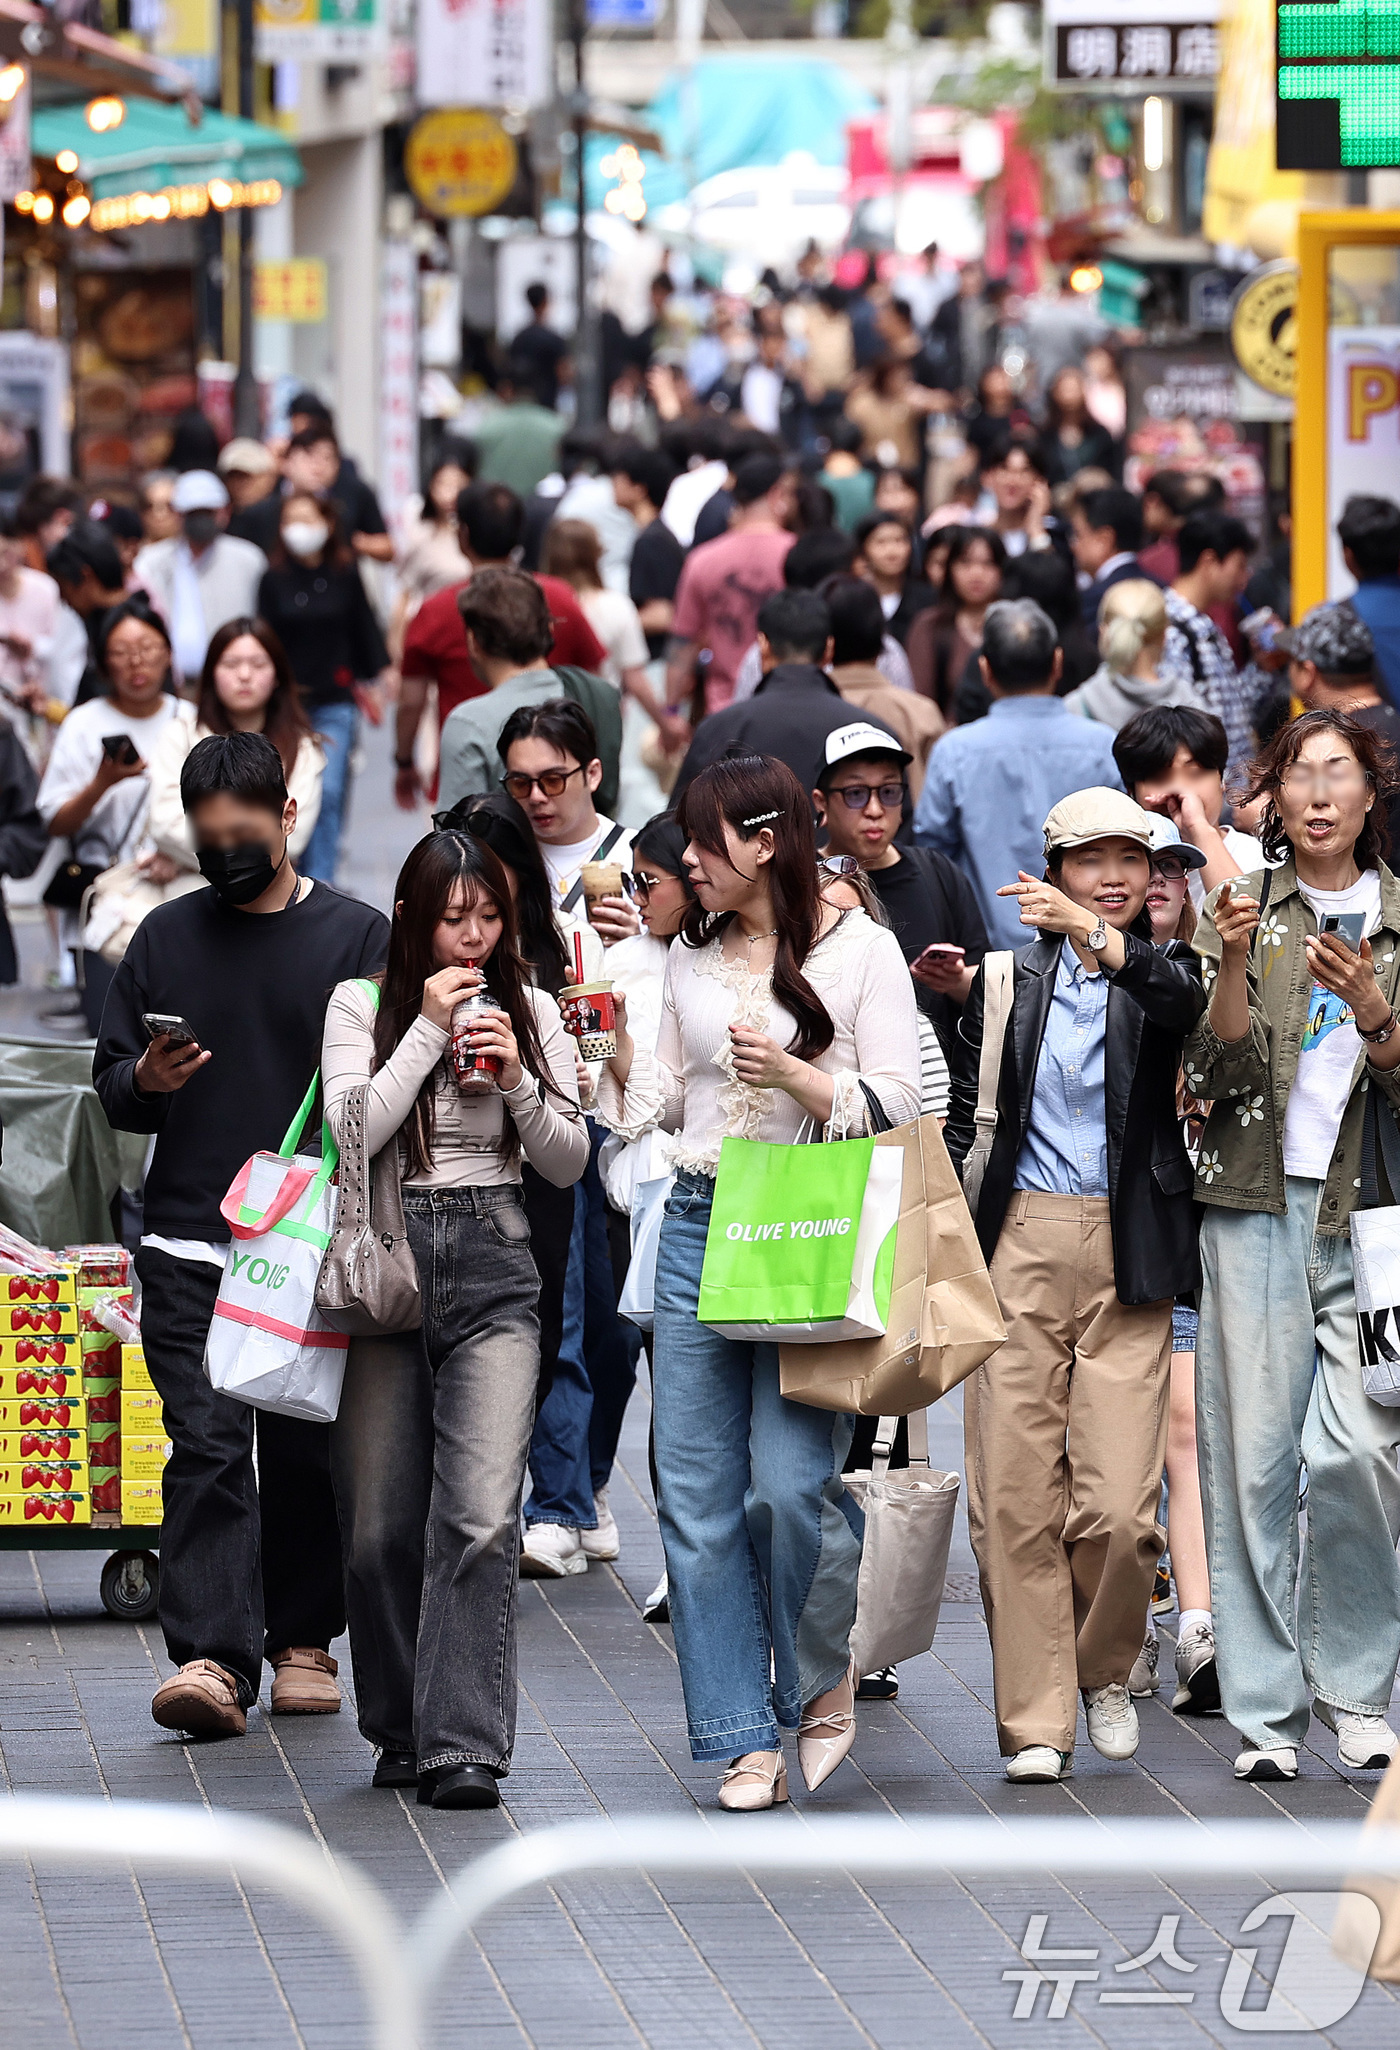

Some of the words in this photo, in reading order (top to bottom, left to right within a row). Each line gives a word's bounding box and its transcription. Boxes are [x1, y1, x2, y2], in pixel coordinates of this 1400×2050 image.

[1067, 26, 1220, 77] 明洞店
[1347, 362, 1400, 443] P
[726, 1222, 786, 1242] OLIVE
[789, 1217, 852, 1239] YOUNG
[1356, 1305, 1400, 1367] K
